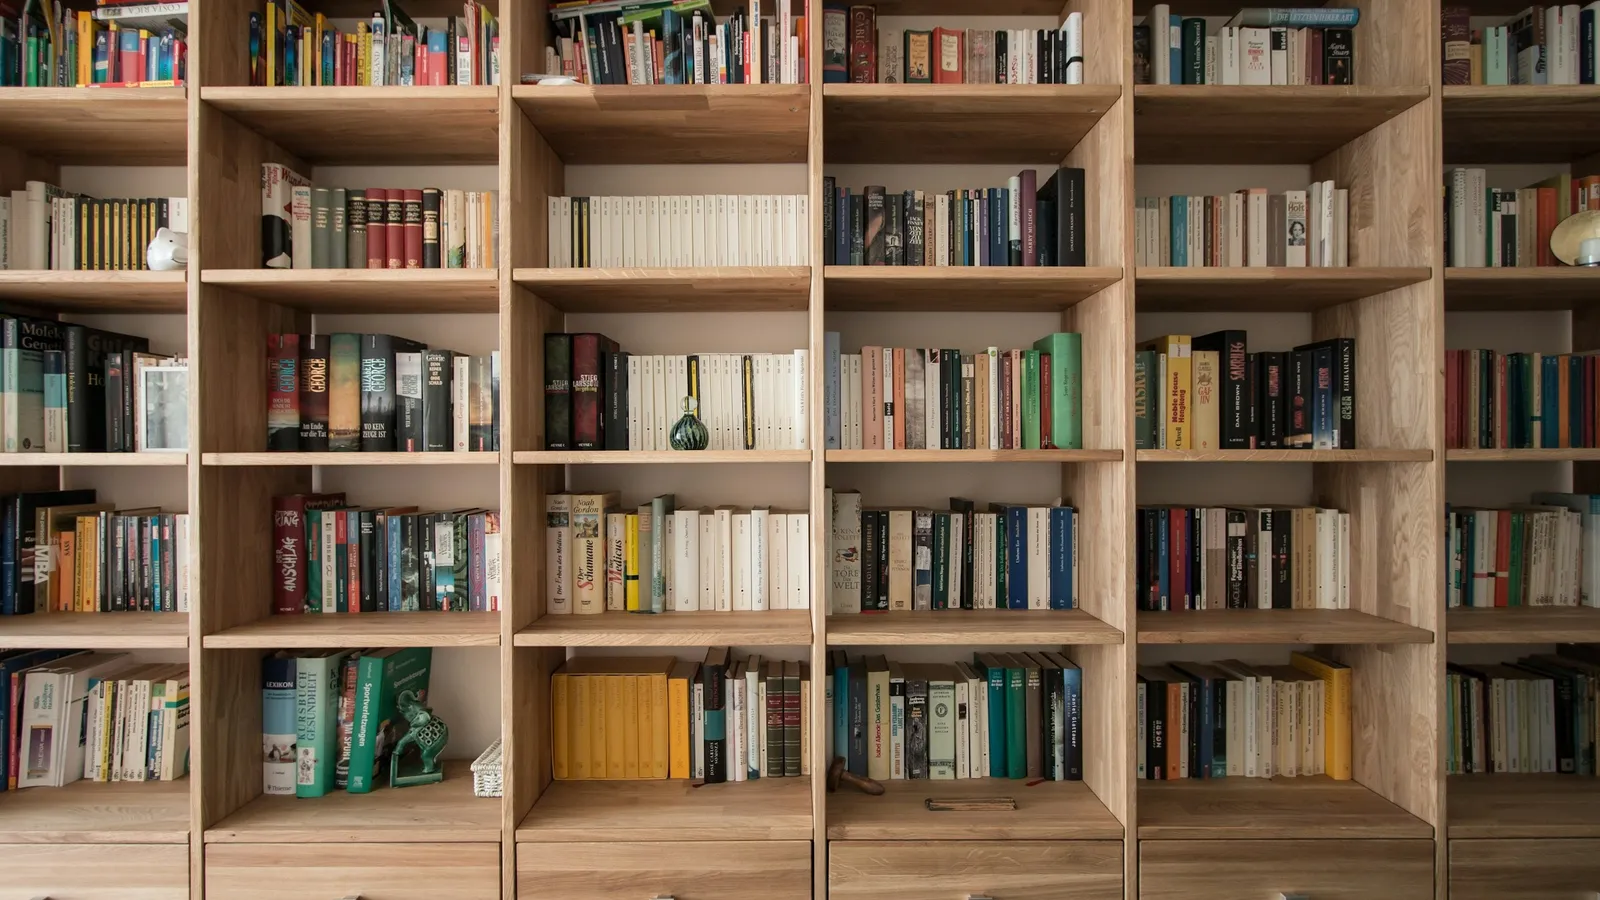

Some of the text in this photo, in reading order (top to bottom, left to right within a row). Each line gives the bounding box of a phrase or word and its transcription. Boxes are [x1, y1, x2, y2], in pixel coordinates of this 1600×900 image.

[127, 4, 181, 14] COSTA RICA
[1276, 13, 1288, 22] DIE
[1340, 13, 1354, 22] ART
[1288, 203, 1305, 213] Holt
[280, 359, 295, 392] GEORGE
[310, 358, 326, 392] GEORGE
[362, 358, 387, 392] ELIZABETH GEORGE
[1230, 341, 1246, 381] SAKRILEG
[1318, 367, 1329, 389] METEOR
[1178, 389, 1186, 423] Hongkong
[309, 430, 317, 438] die
[318, 430, 327, 438] Tat
[310, 422, 324, 430] Ende
[573, 506, 600, 514] Gordon
[577, 499, 595, 507] Noah
[276, 517, 299, 527] KING
[35, 544, 50, 585] MBA
[281, 536, 298, 592] ANSCHLAG
[554, 531, 563, 595] Die Erben des Medicus
[576, 539, 594, 591] Schamane
[608, 539, 623, 585] Medicus
[834, 570, 859, 578] TORE
[833, 581, 860, 590] WELT
[297, 671, 307, 741] KURSBUCH
[306, 671, 317, 741] GESUNDHEIT
[358, 682, 373, 747] Sportverletzungen
[874, 683, 882, 758] Isabel Allende Das Geisterhaus
[345, 722, 354, 734] IM
